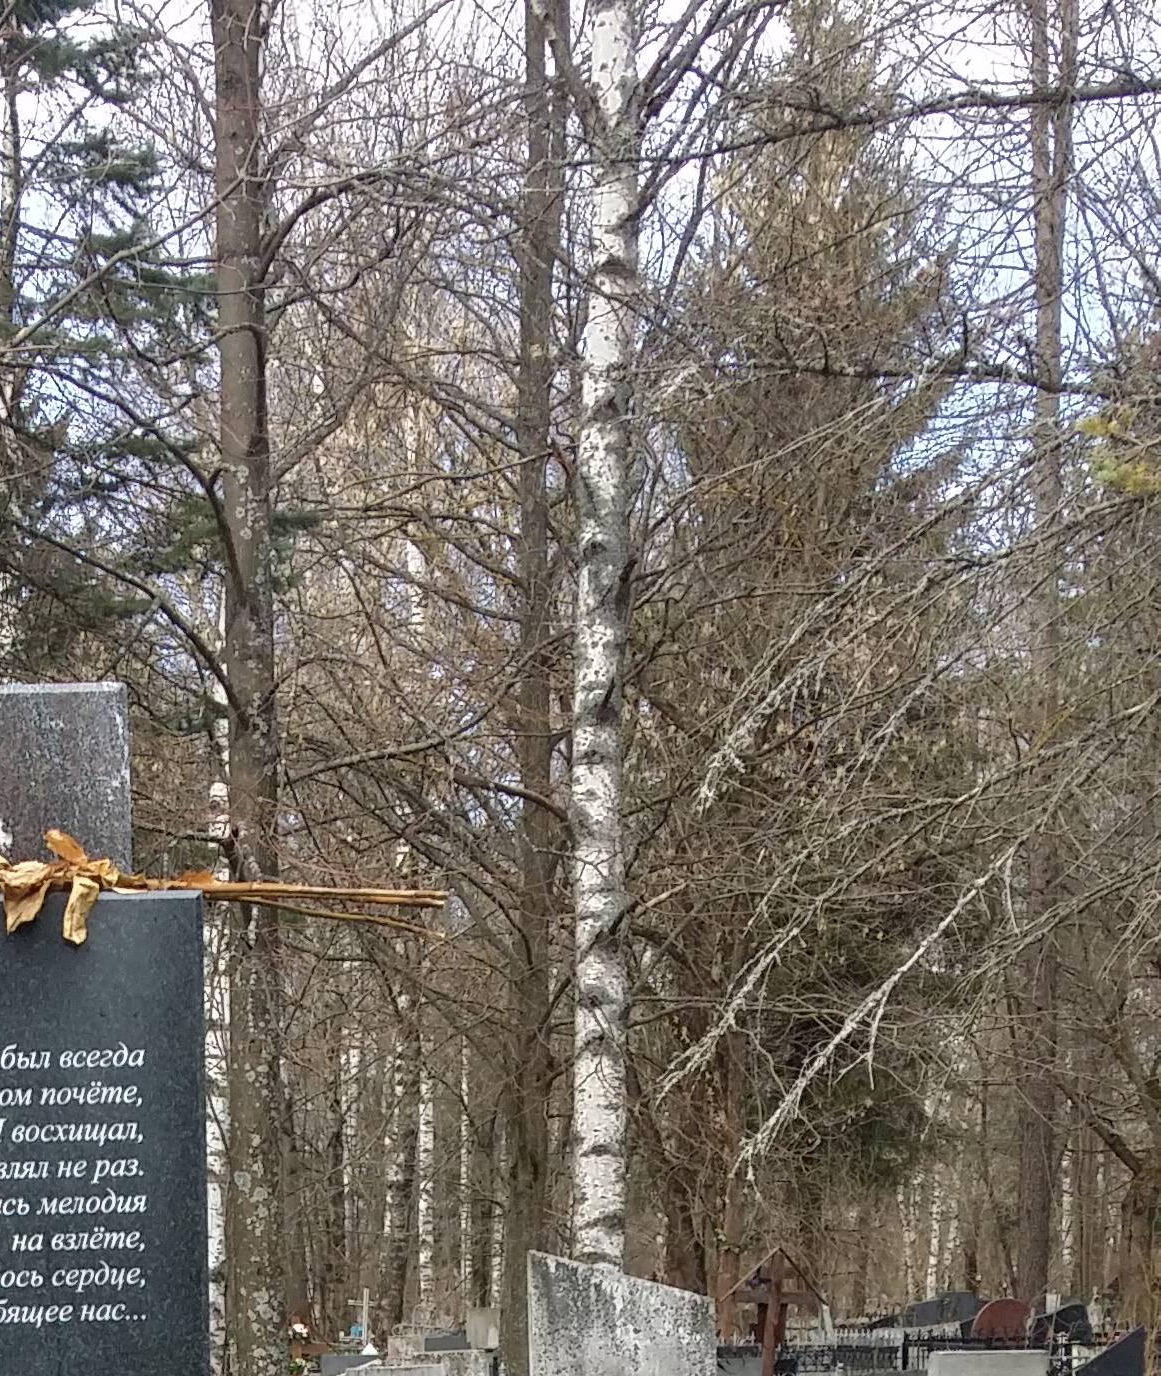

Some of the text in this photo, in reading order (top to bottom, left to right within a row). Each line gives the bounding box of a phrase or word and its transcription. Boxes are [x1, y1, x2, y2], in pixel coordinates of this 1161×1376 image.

[1, 1044, 51, 1069] был
[59, 1042, 145, 1068] всегда
[41, 1081, 144, 1108] почёте,
[11, 1122, 144, 1146] восхищал,
[58, 1158, 87, 1178] не
[91, 1158, 144, 1183] раз.
[37, 1188, 147, 1216] мелодия
[12, 1226, 146, 1252] на взлёте,
[51, 1261, 147, 1292] сердце,
[80, 1302, 147, 1322] нас...
